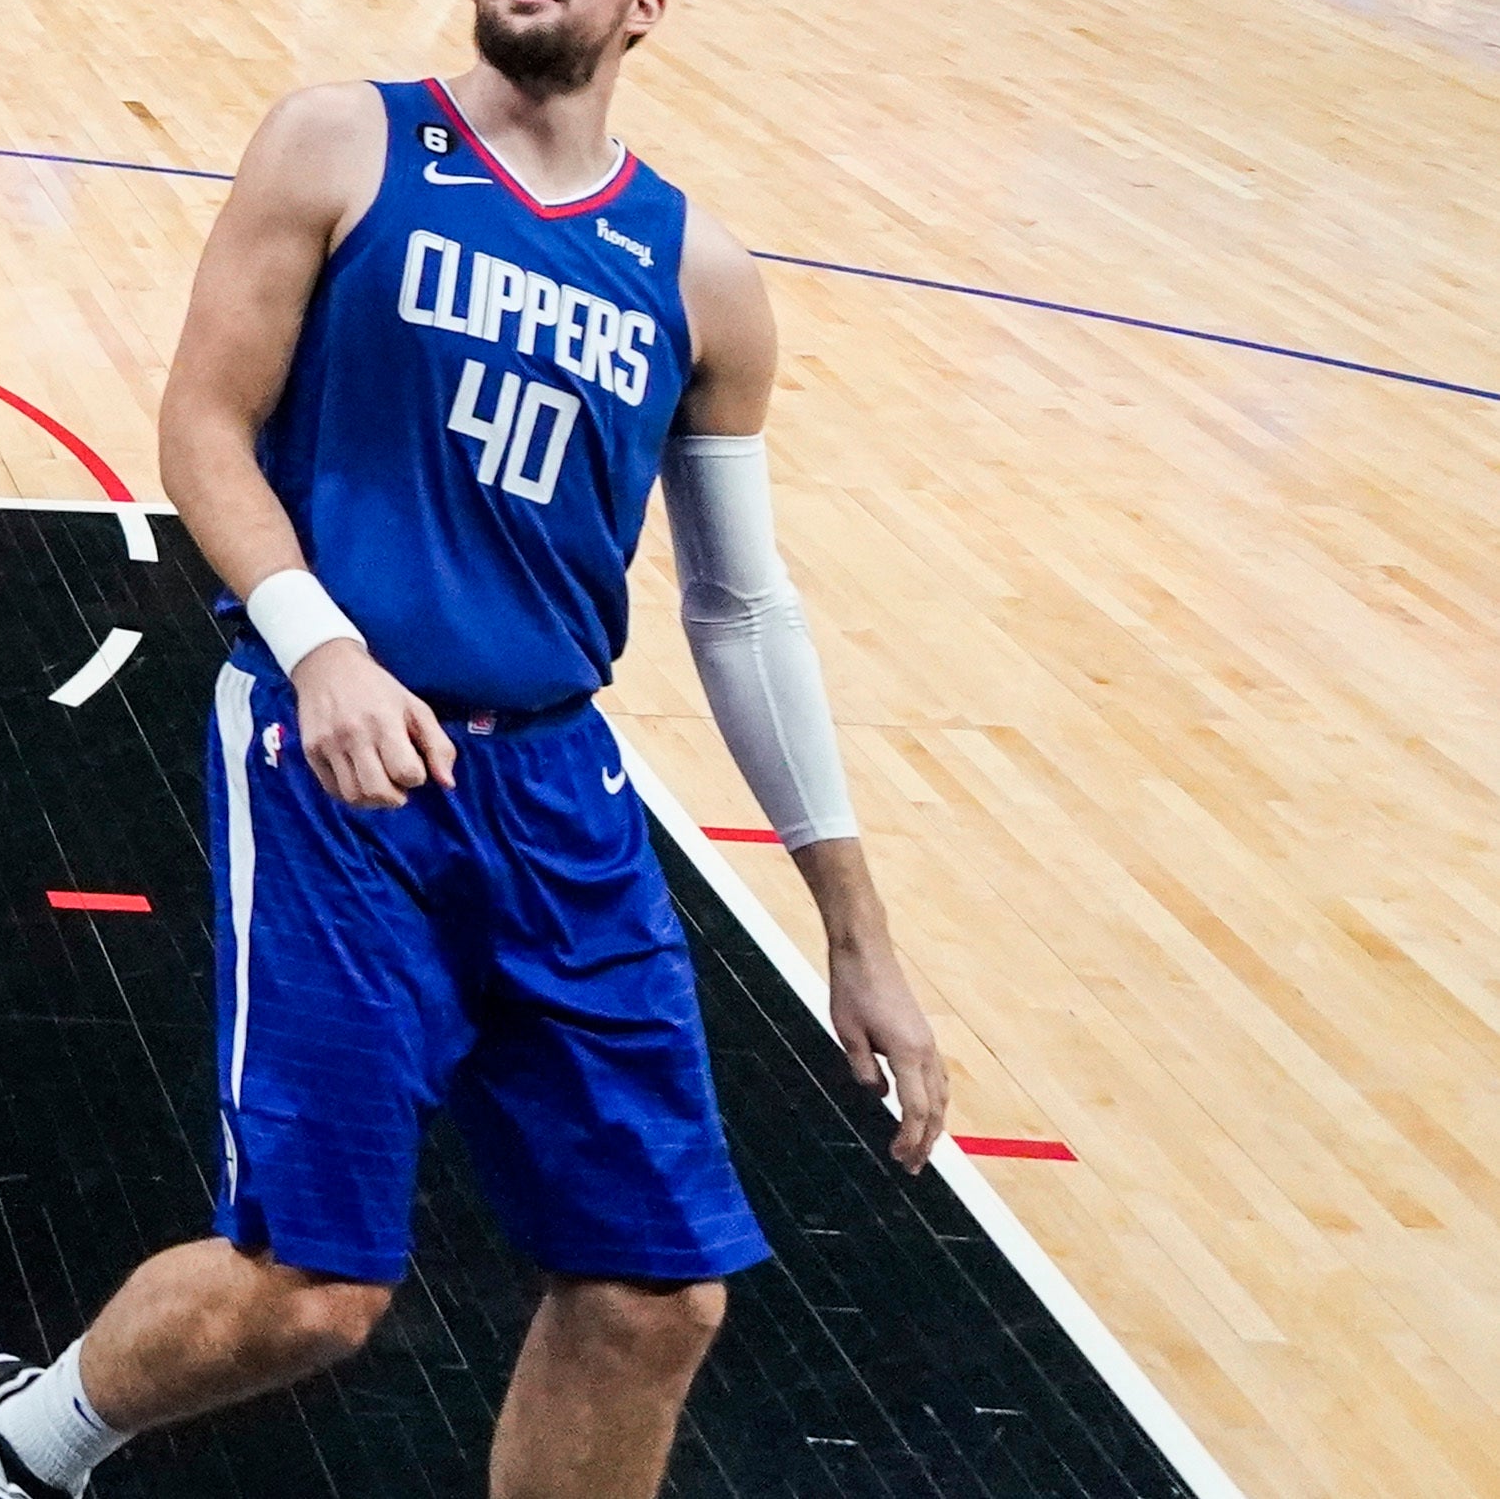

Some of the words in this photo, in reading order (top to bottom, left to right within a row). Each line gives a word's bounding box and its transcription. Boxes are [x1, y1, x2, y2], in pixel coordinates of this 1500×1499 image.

[423, 126, 448, 153] 6
[596, 218, 654, 268] honey
[398, 229, 656, 407] CLIPPERS
[447, 358, 581, 505] 40
